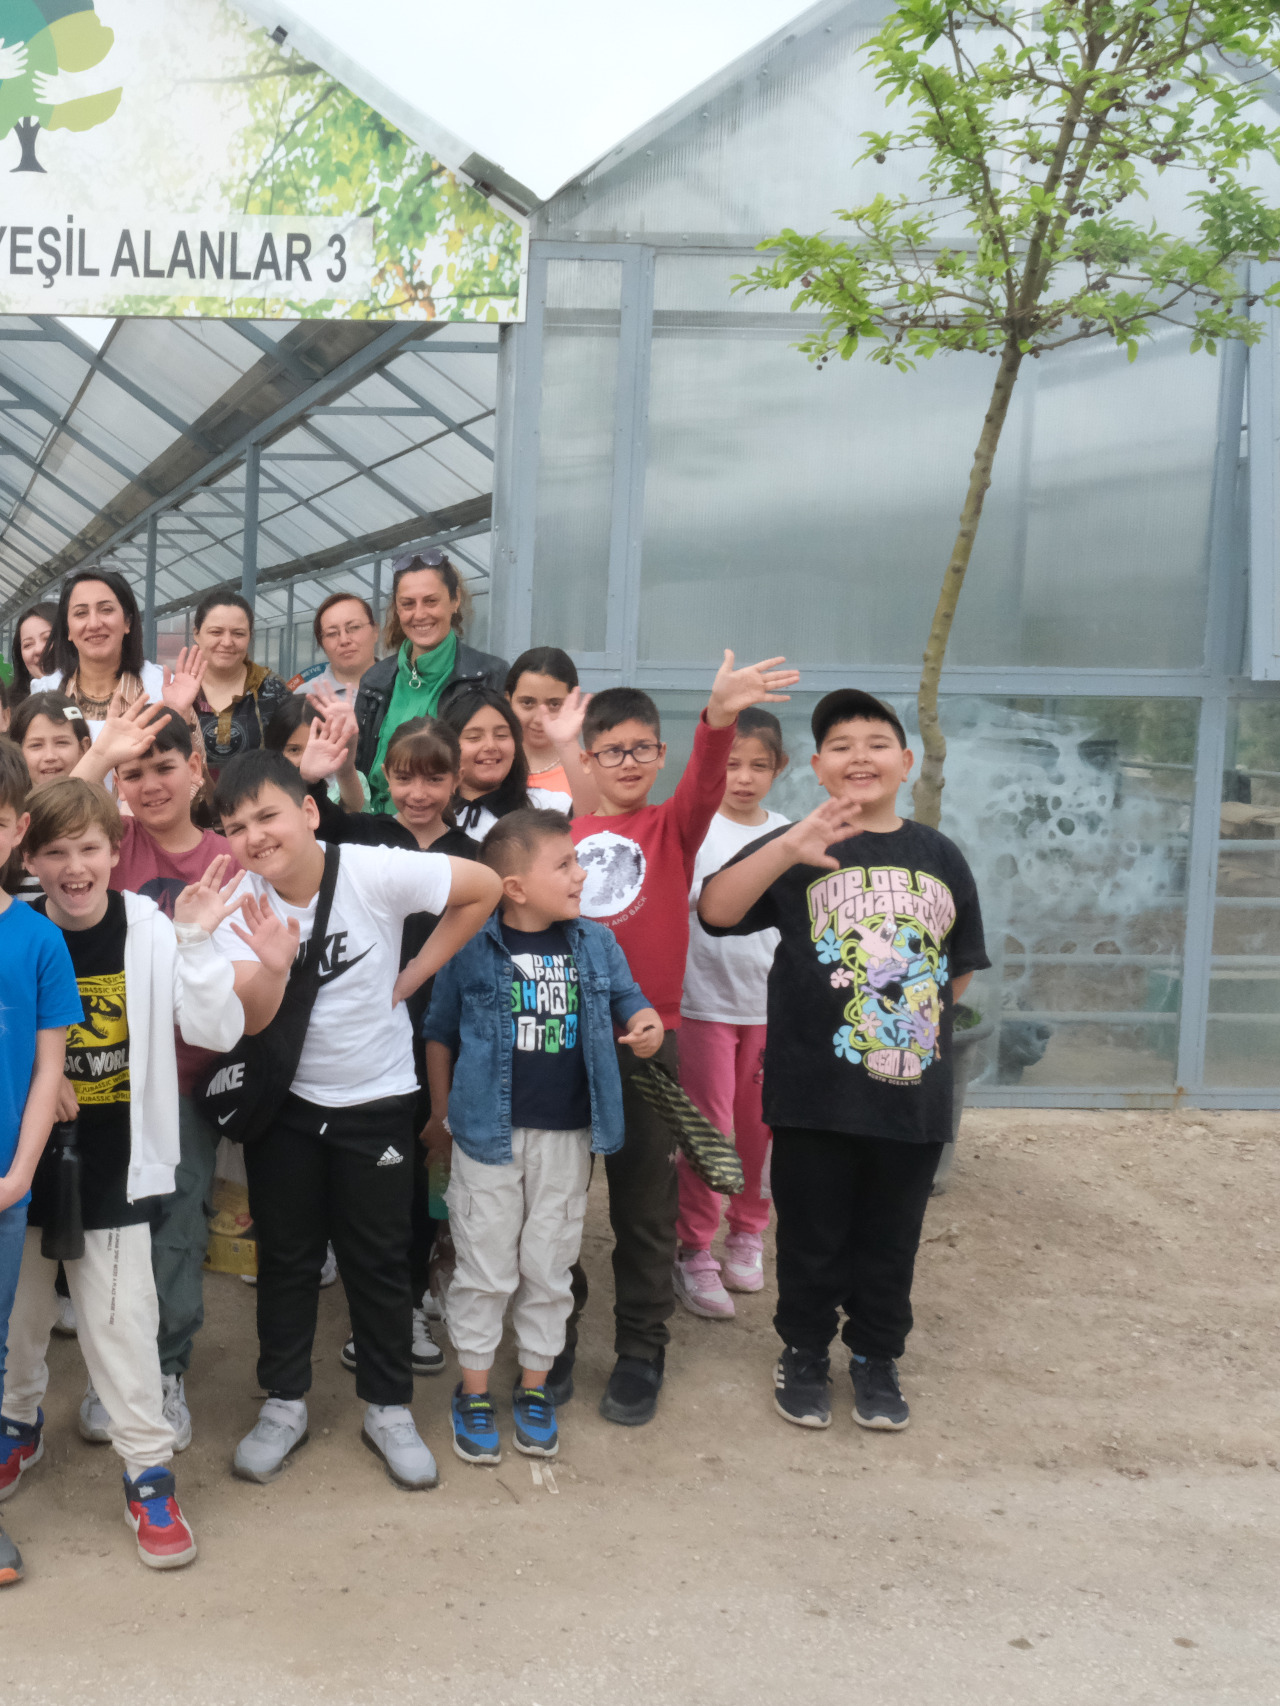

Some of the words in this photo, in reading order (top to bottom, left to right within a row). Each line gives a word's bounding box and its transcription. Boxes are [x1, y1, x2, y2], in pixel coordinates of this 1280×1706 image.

[110, 229, 313, 282] ALANLAR
[326, 233, 348, 283] 3
[612, 914, 629, 926] AND
[628, 896, 648, 915] BACK
[810, 869, 863, 939] TOP
[871, 869, 908, 892] OF
[918, 874, 956, 939] THE
[533, 954, 575, 968] DON'T
[535, 967, 579, 982] PANIC
[512, 1014, 578, 1054] TTACK
[86, 1048, 130, 1077] WORL
[81, 1080, 112, 1093] JURASSIC
[206, 1062, 246, 1098] NIKE
